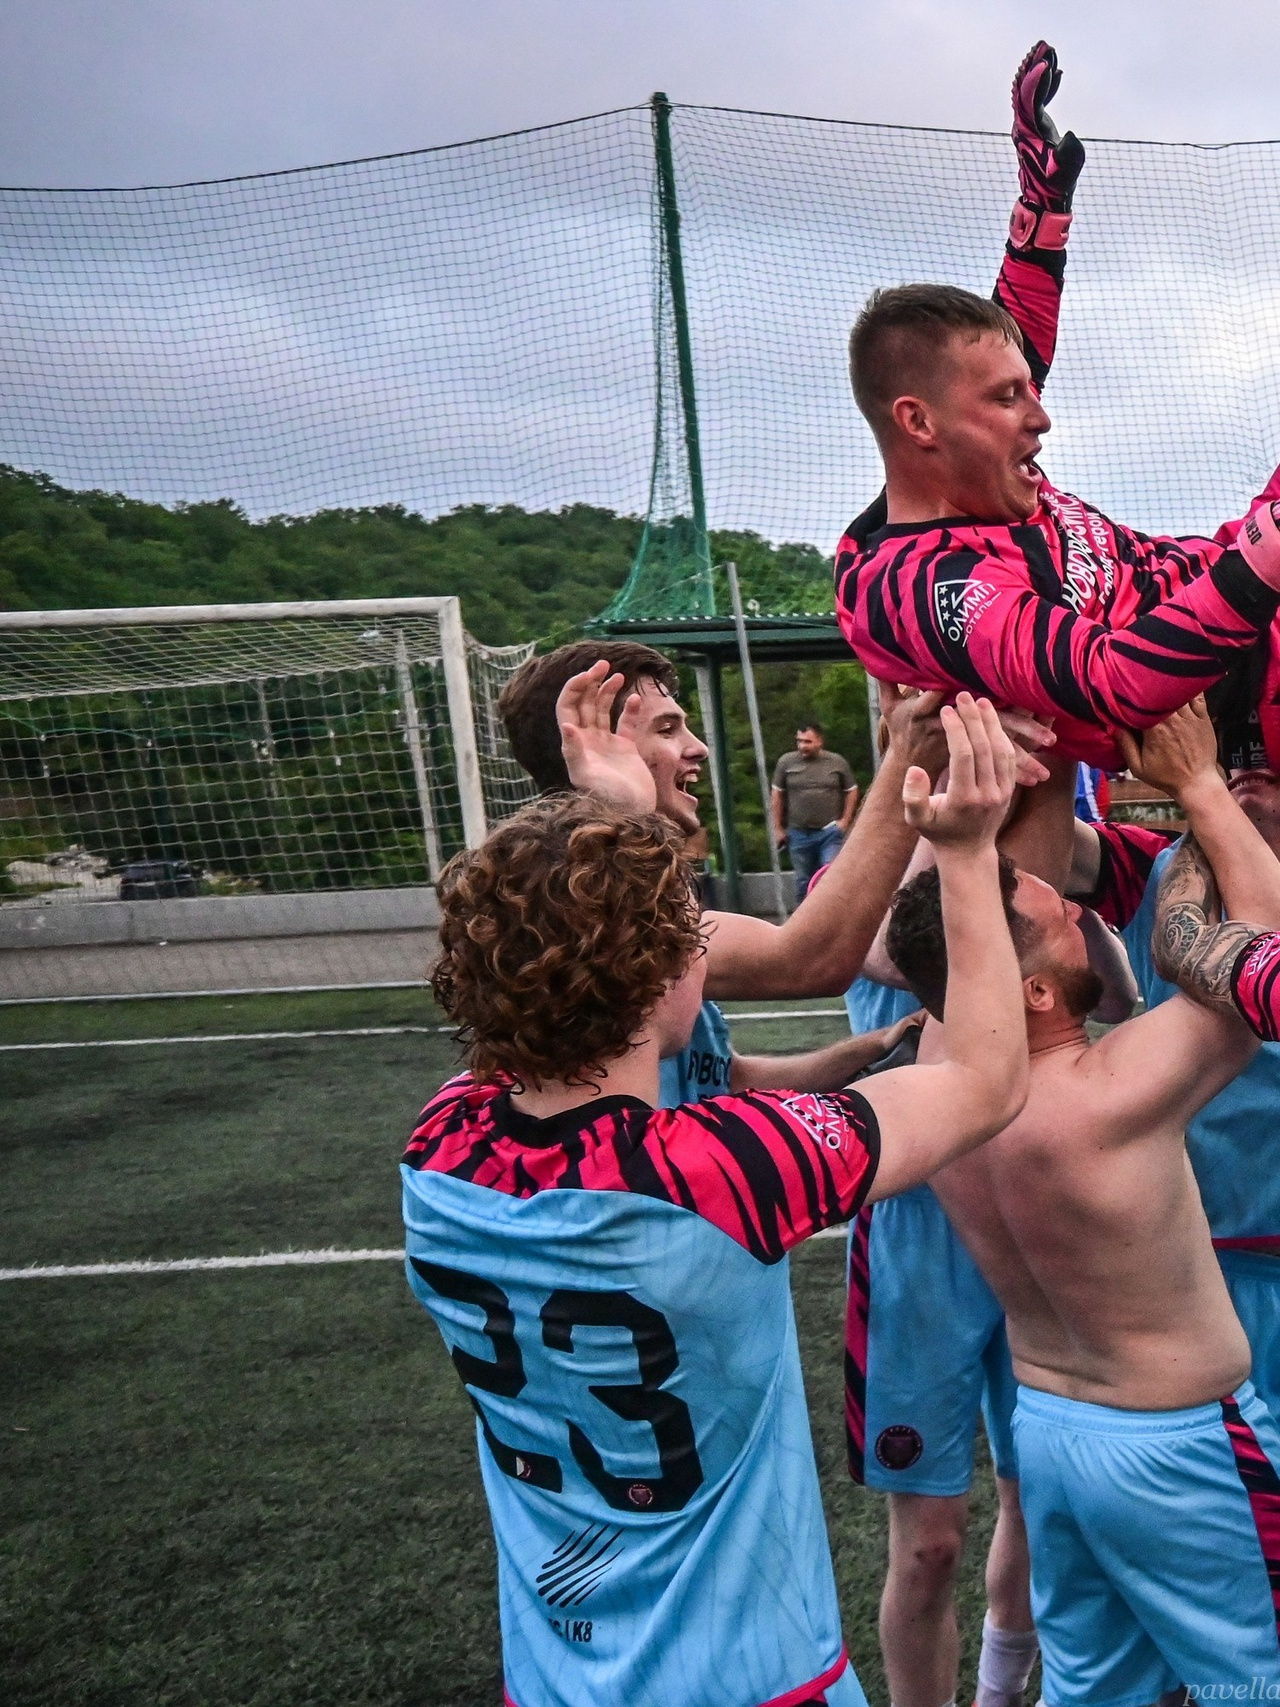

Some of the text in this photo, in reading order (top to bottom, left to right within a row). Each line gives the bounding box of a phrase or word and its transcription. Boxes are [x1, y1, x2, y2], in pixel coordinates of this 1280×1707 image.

[948, 583, 996, 642] ОЛИМП
[965, 600, 993, 635] ОТЕЛЬ
[409, 1255, 704, 1513] 23
